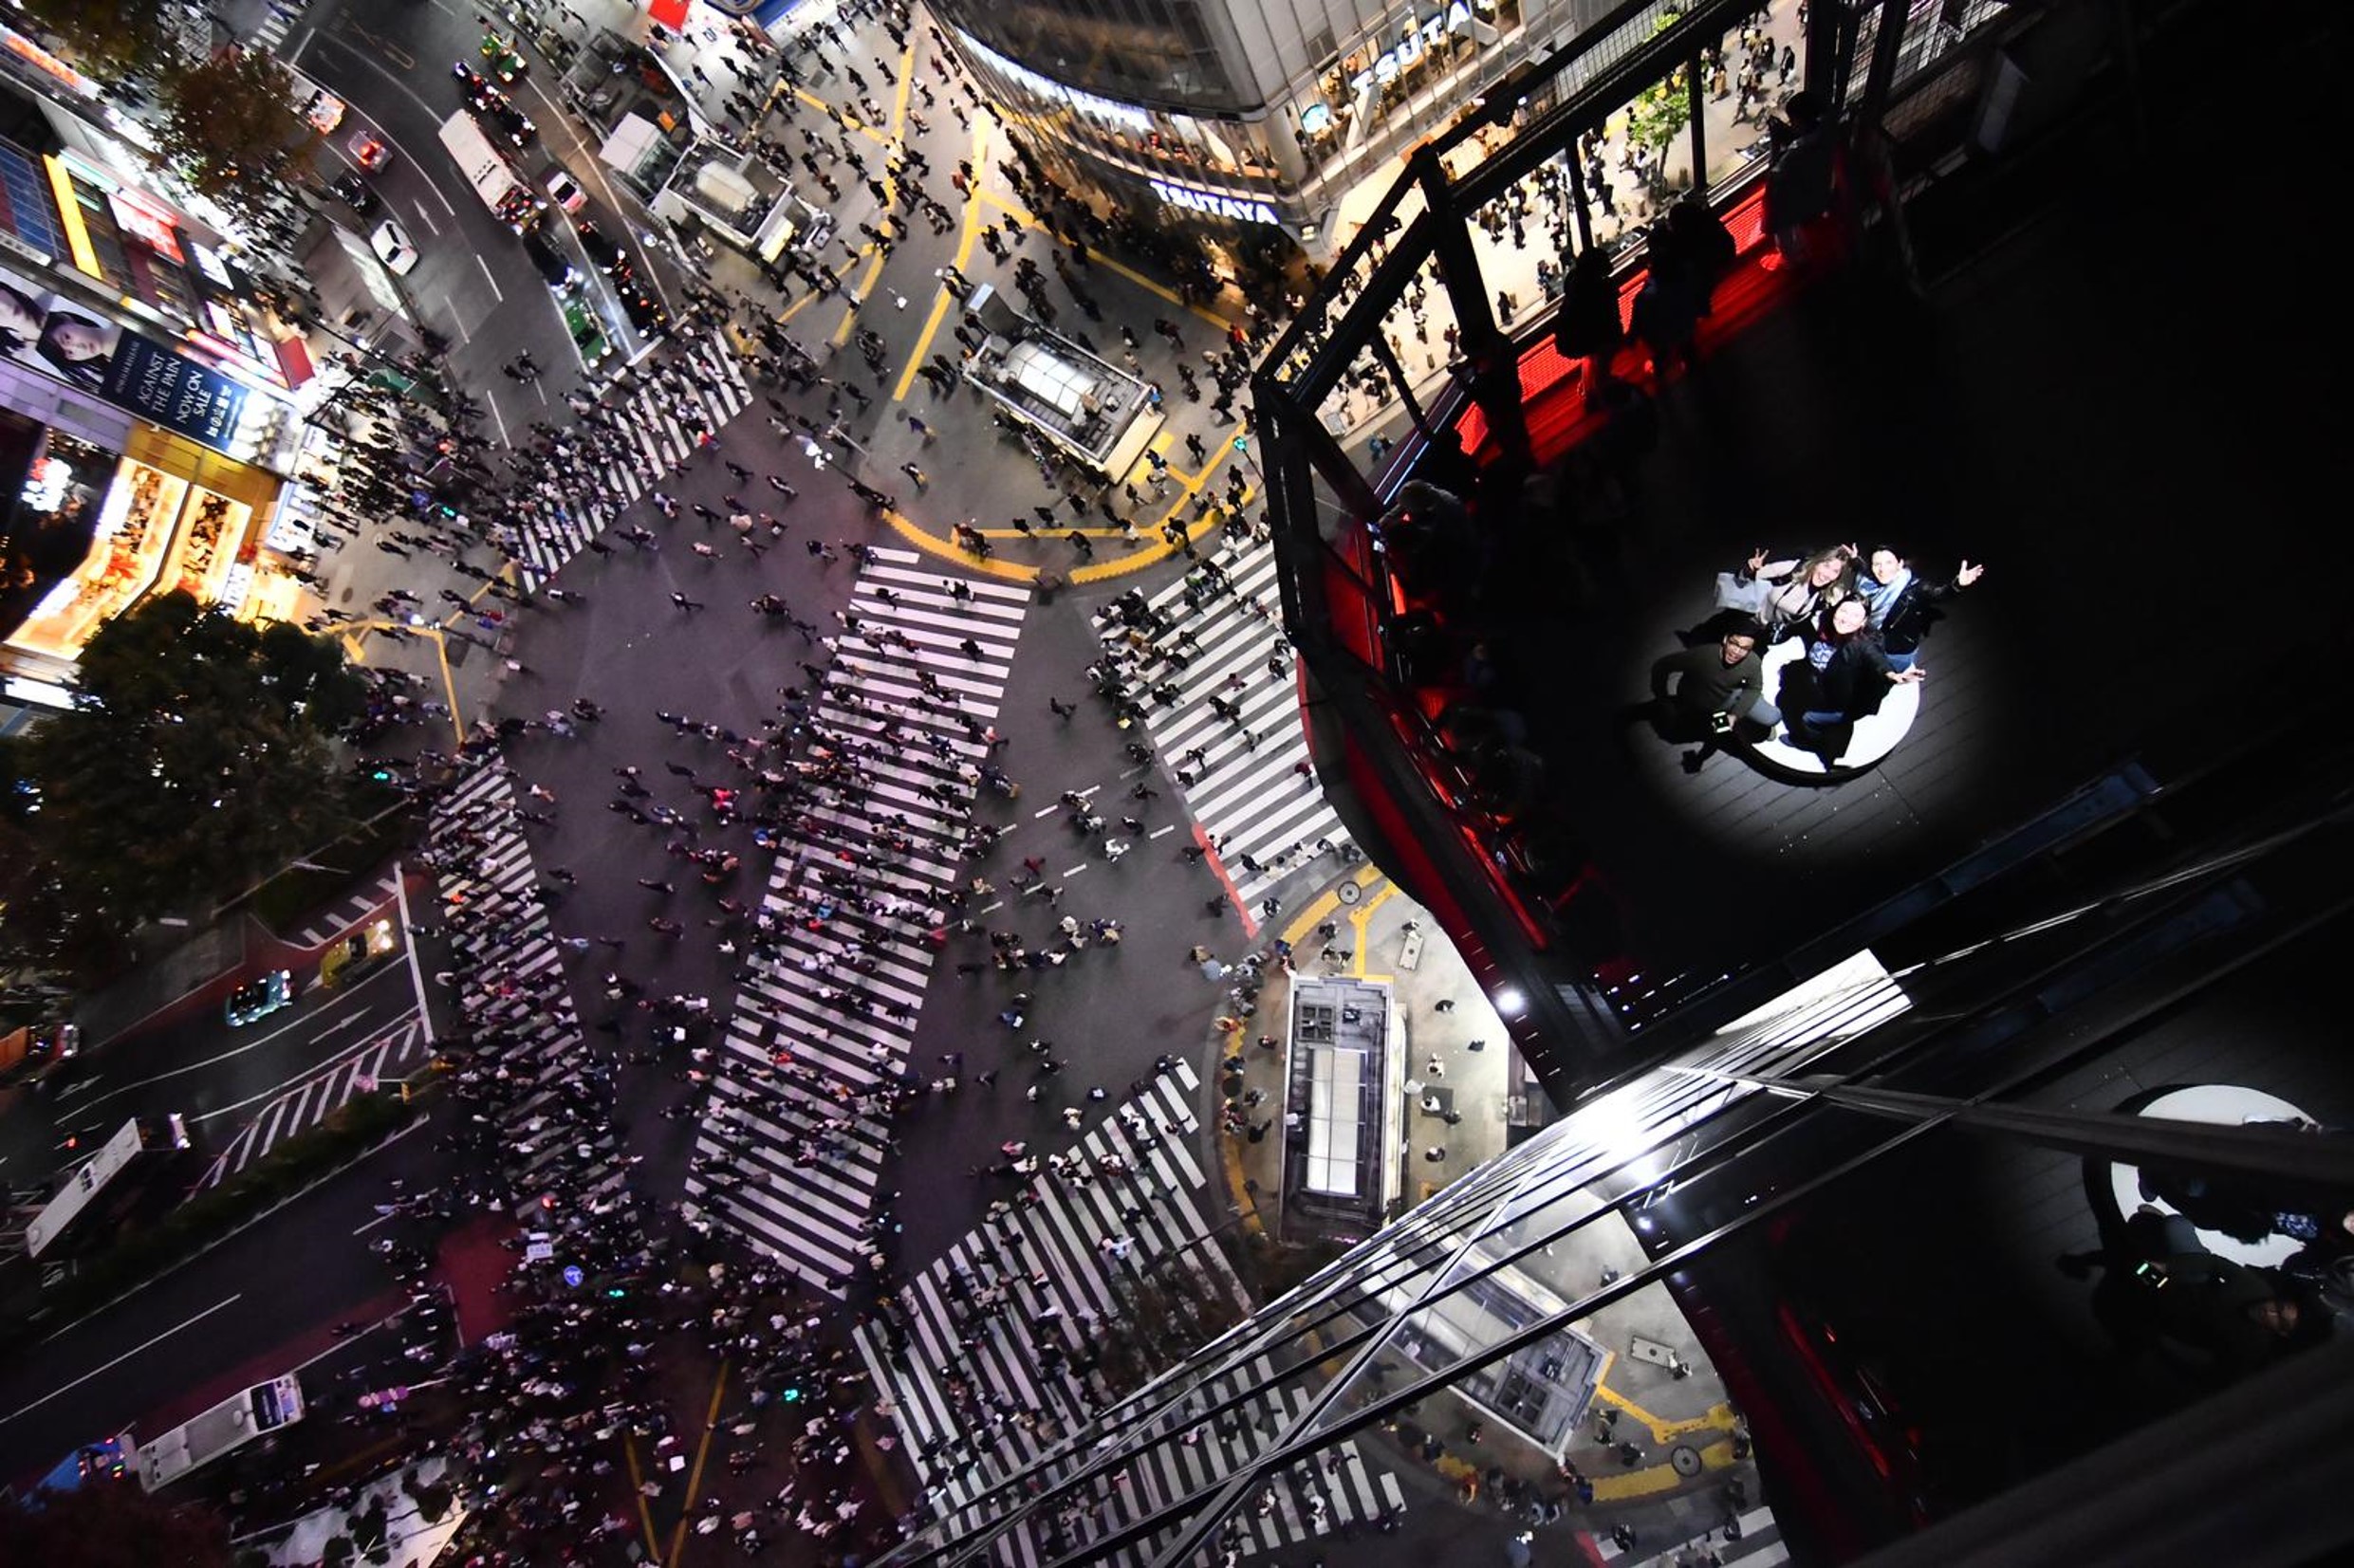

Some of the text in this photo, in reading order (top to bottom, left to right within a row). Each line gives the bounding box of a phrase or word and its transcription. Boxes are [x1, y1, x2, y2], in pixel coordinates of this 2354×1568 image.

[1149, 180, 1279, 225] TSUTAYA
[139, 352, 165, 404] AGAINST
[153, 357, 182, 413] THE PAIN
[176, 370, 203, 424] NOW ON
[193, 390, 212, 416] SALE
